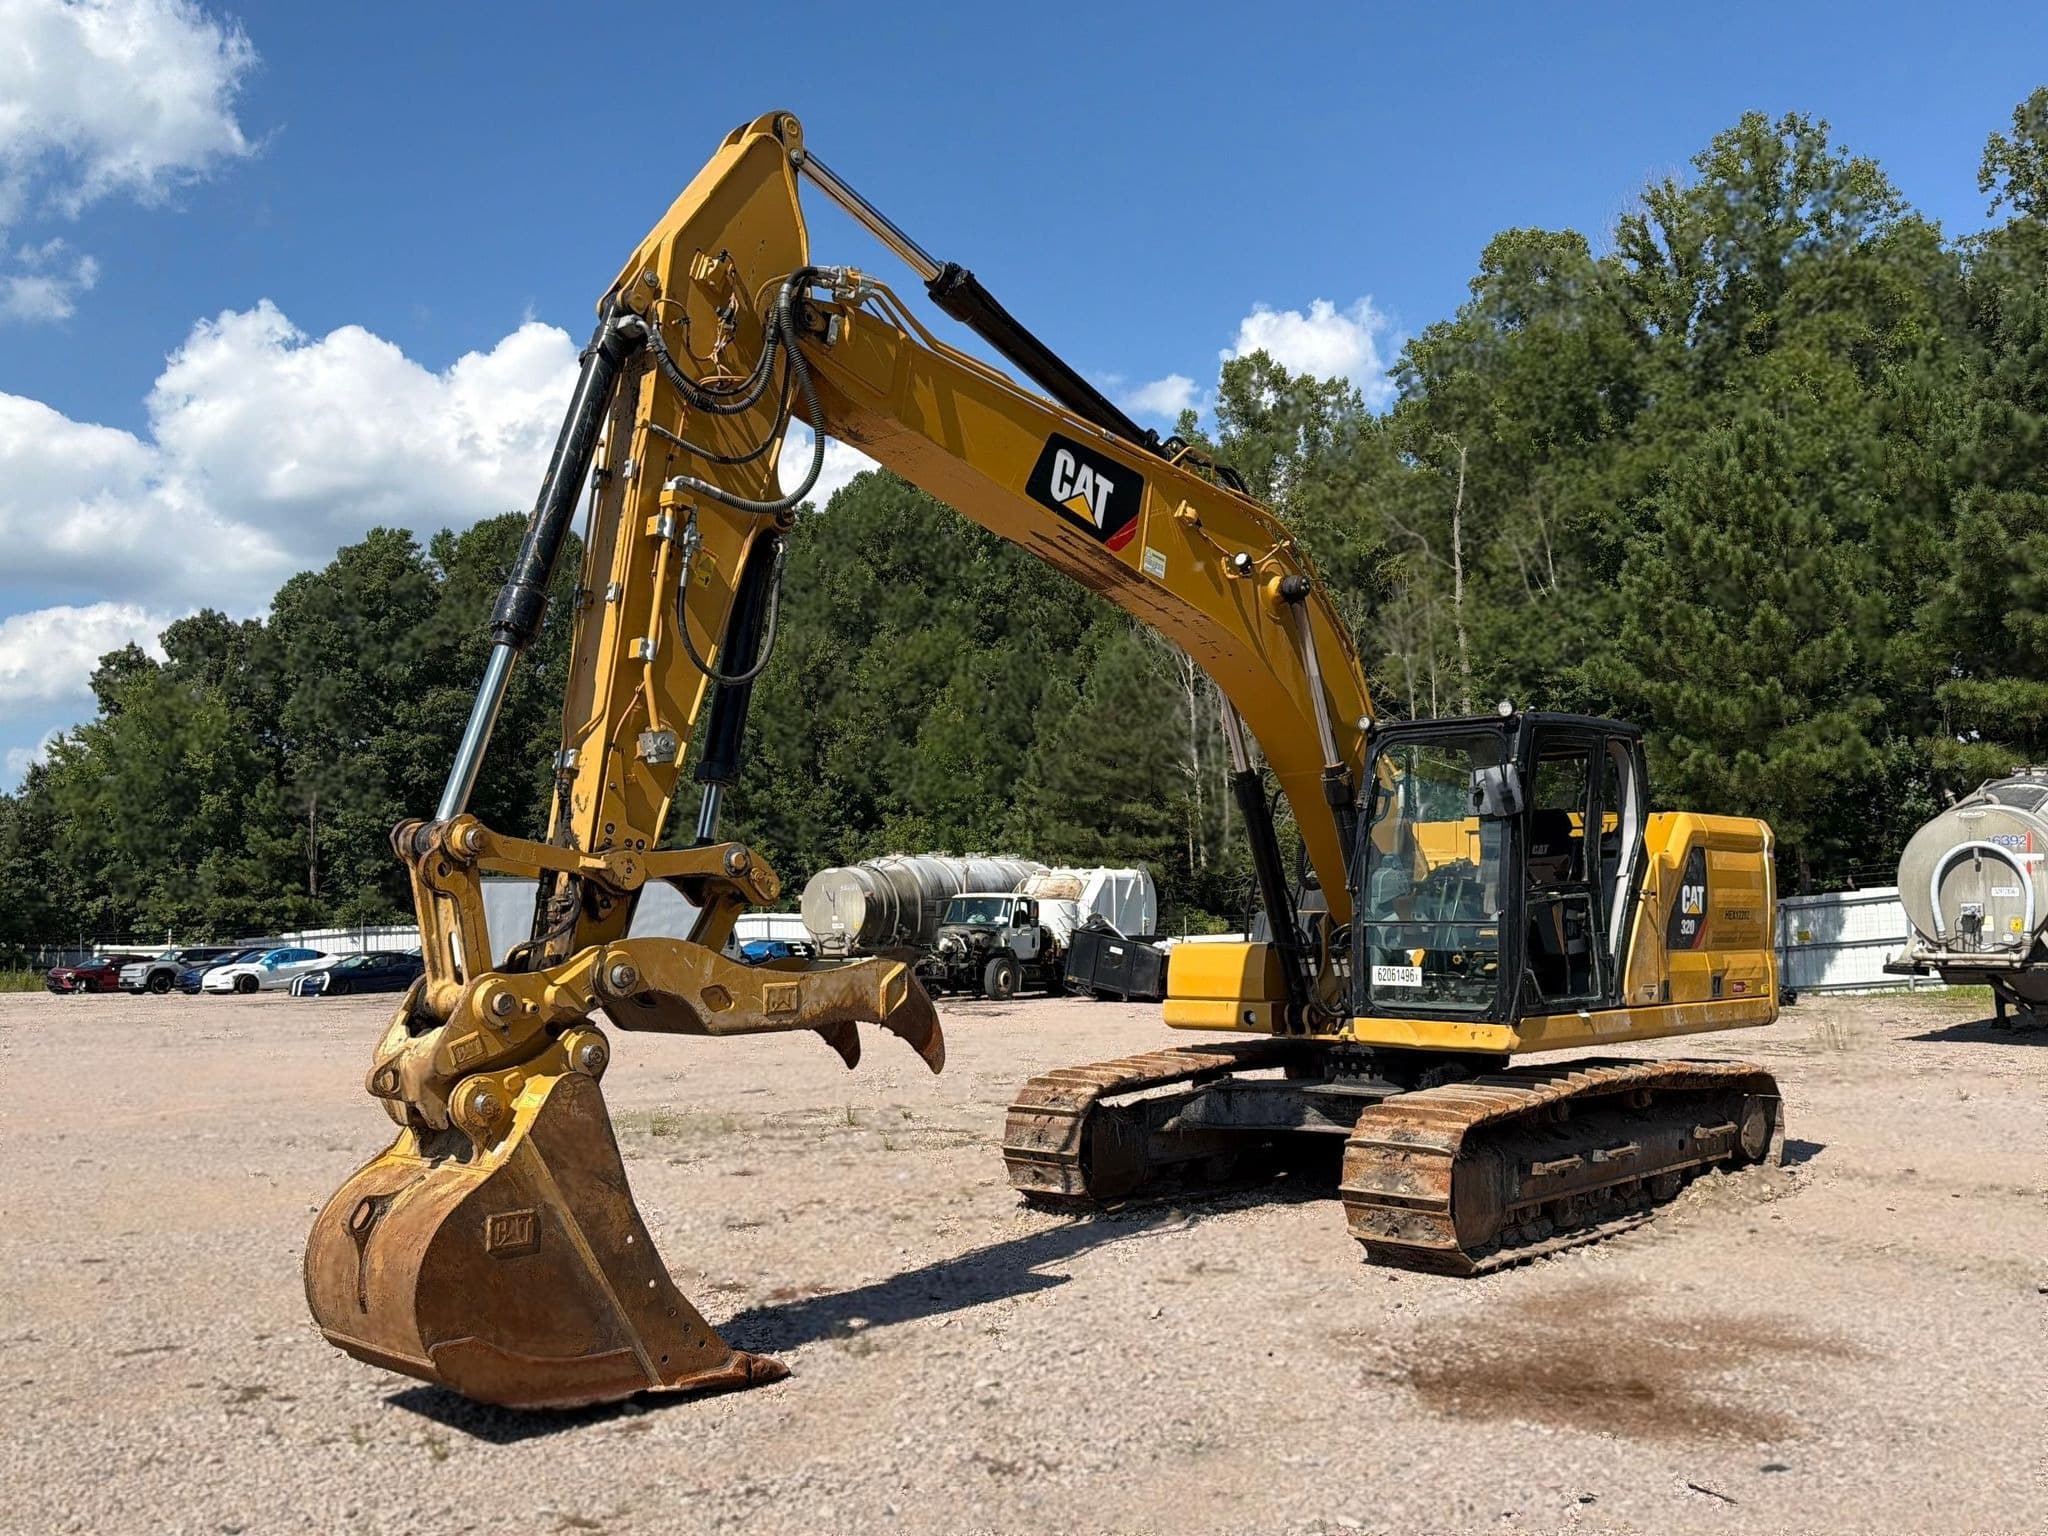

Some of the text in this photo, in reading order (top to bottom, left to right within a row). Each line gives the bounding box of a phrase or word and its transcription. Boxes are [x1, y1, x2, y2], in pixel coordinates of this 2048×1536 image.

[1050, 448, 1114, 529] CAT
[1682, 885, 1704, 914] CAT
[1681, 919, 1695, 934] 320
[1377, 967, 1415, 982] 62061496
